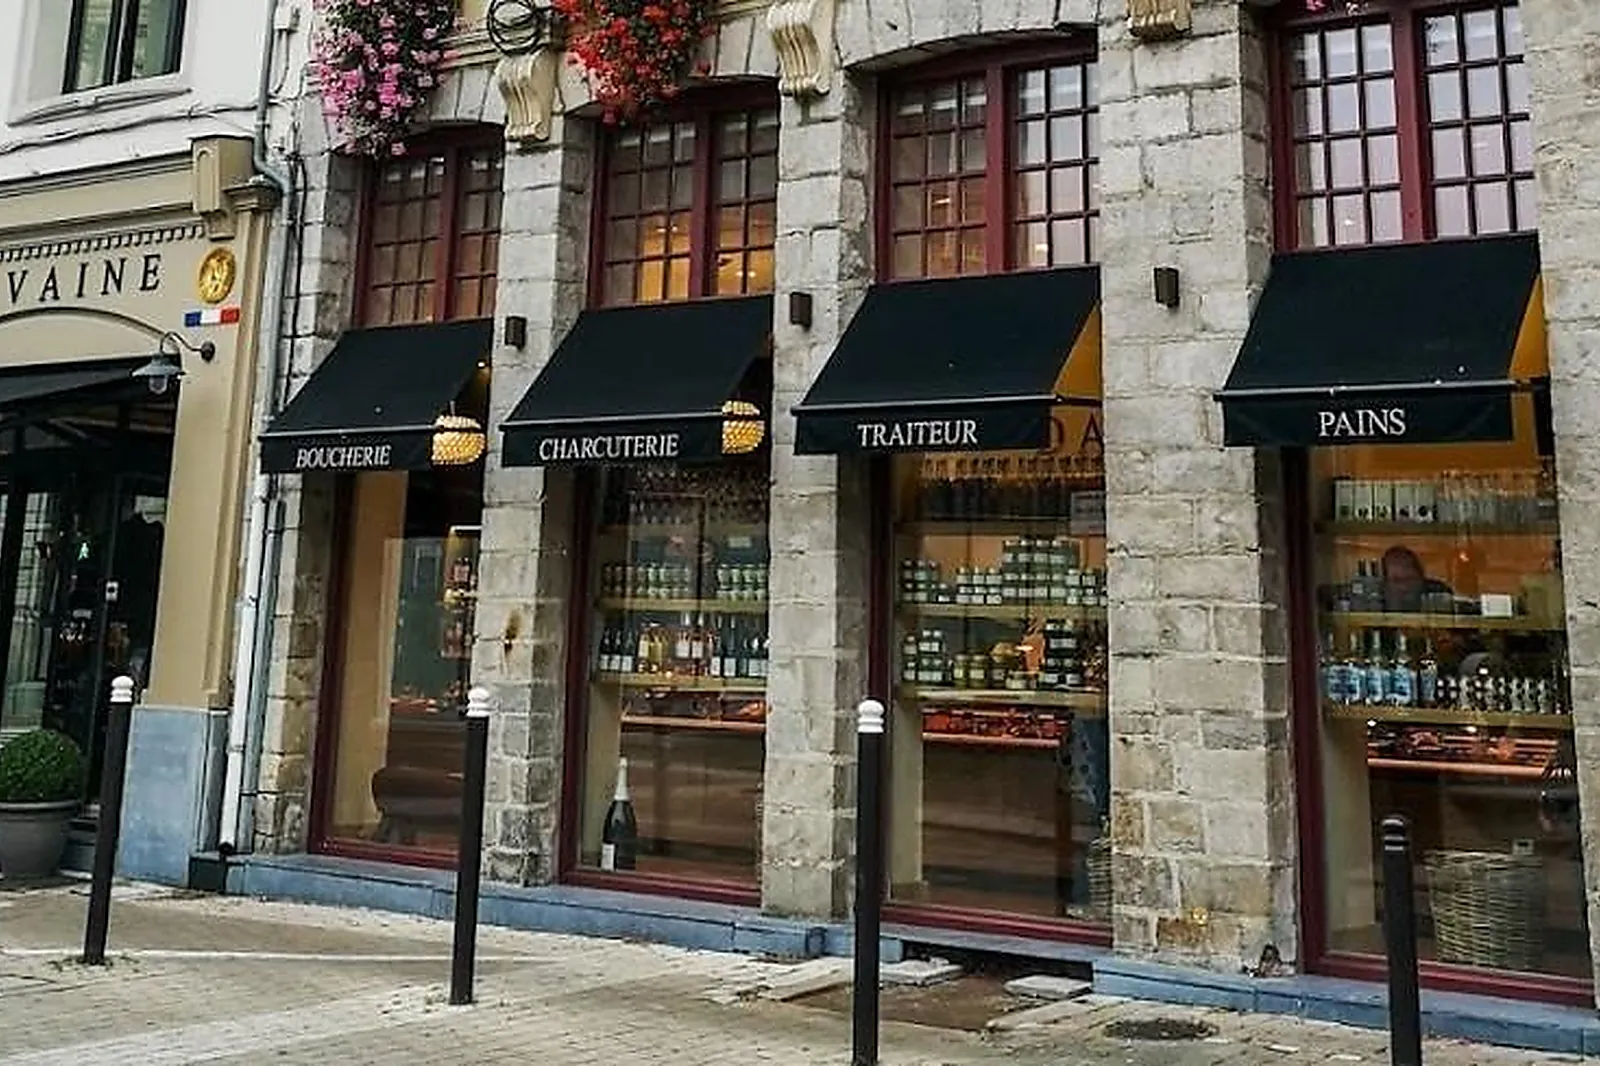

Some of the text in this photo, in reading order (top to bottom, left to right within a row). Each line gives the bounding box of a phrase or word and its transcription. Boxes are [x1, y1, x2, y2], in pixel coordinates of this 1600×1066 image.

[7, 254, 162, 303] VAINE
[858, 419, 978, 448] TRAITEUR
[1318, 409, 1407, 438] PAINS
[295, 444, 392, 469] BOUCHERIE
[538, 433, 679, 462] CHARCUTERIE
